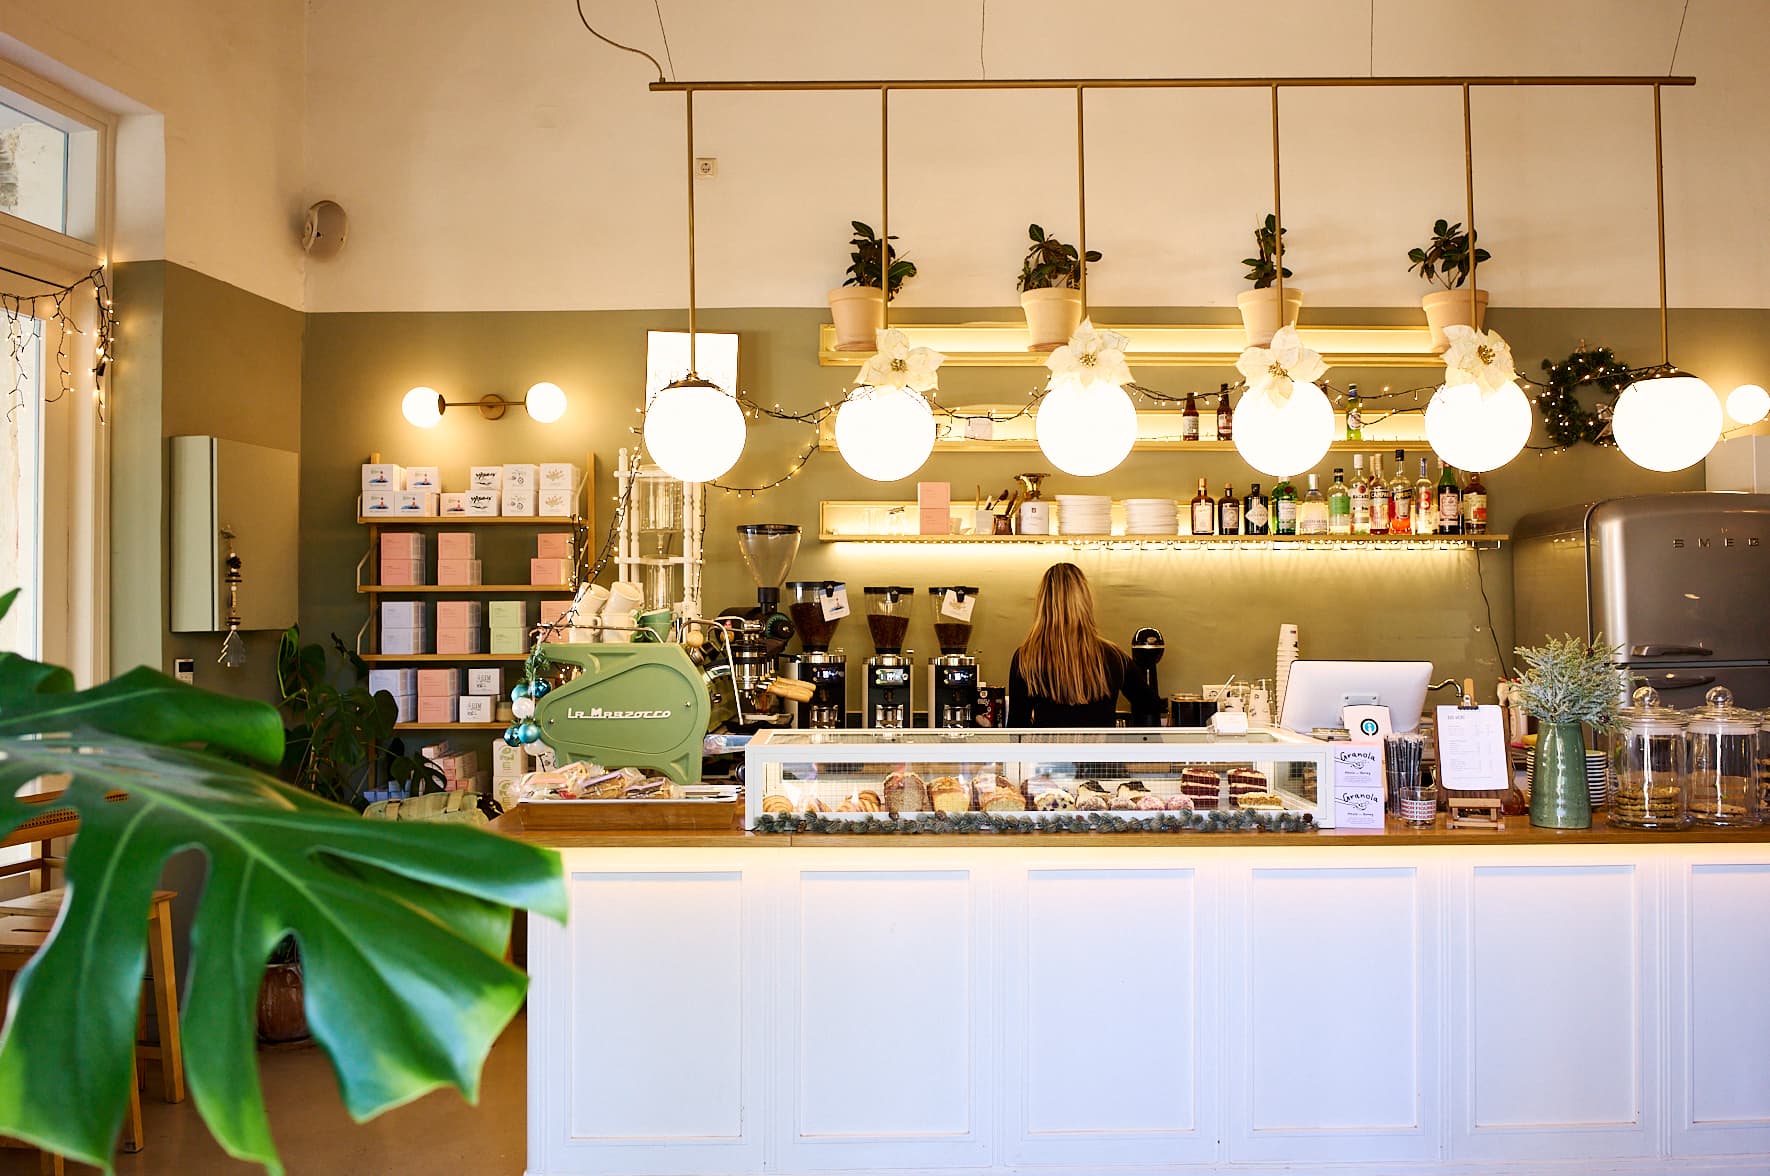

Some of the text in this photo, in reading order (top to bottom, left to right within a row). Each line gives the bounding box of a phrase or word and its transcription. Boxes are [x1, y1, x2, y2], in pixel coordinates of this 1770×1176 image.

[1672, 537, 1760, 548] SMEG
[568, 707, 671, 719] La Marzocco
[1340, 751, 1375, 762] Granola
[1342, 792, 1378, 803] Granola
